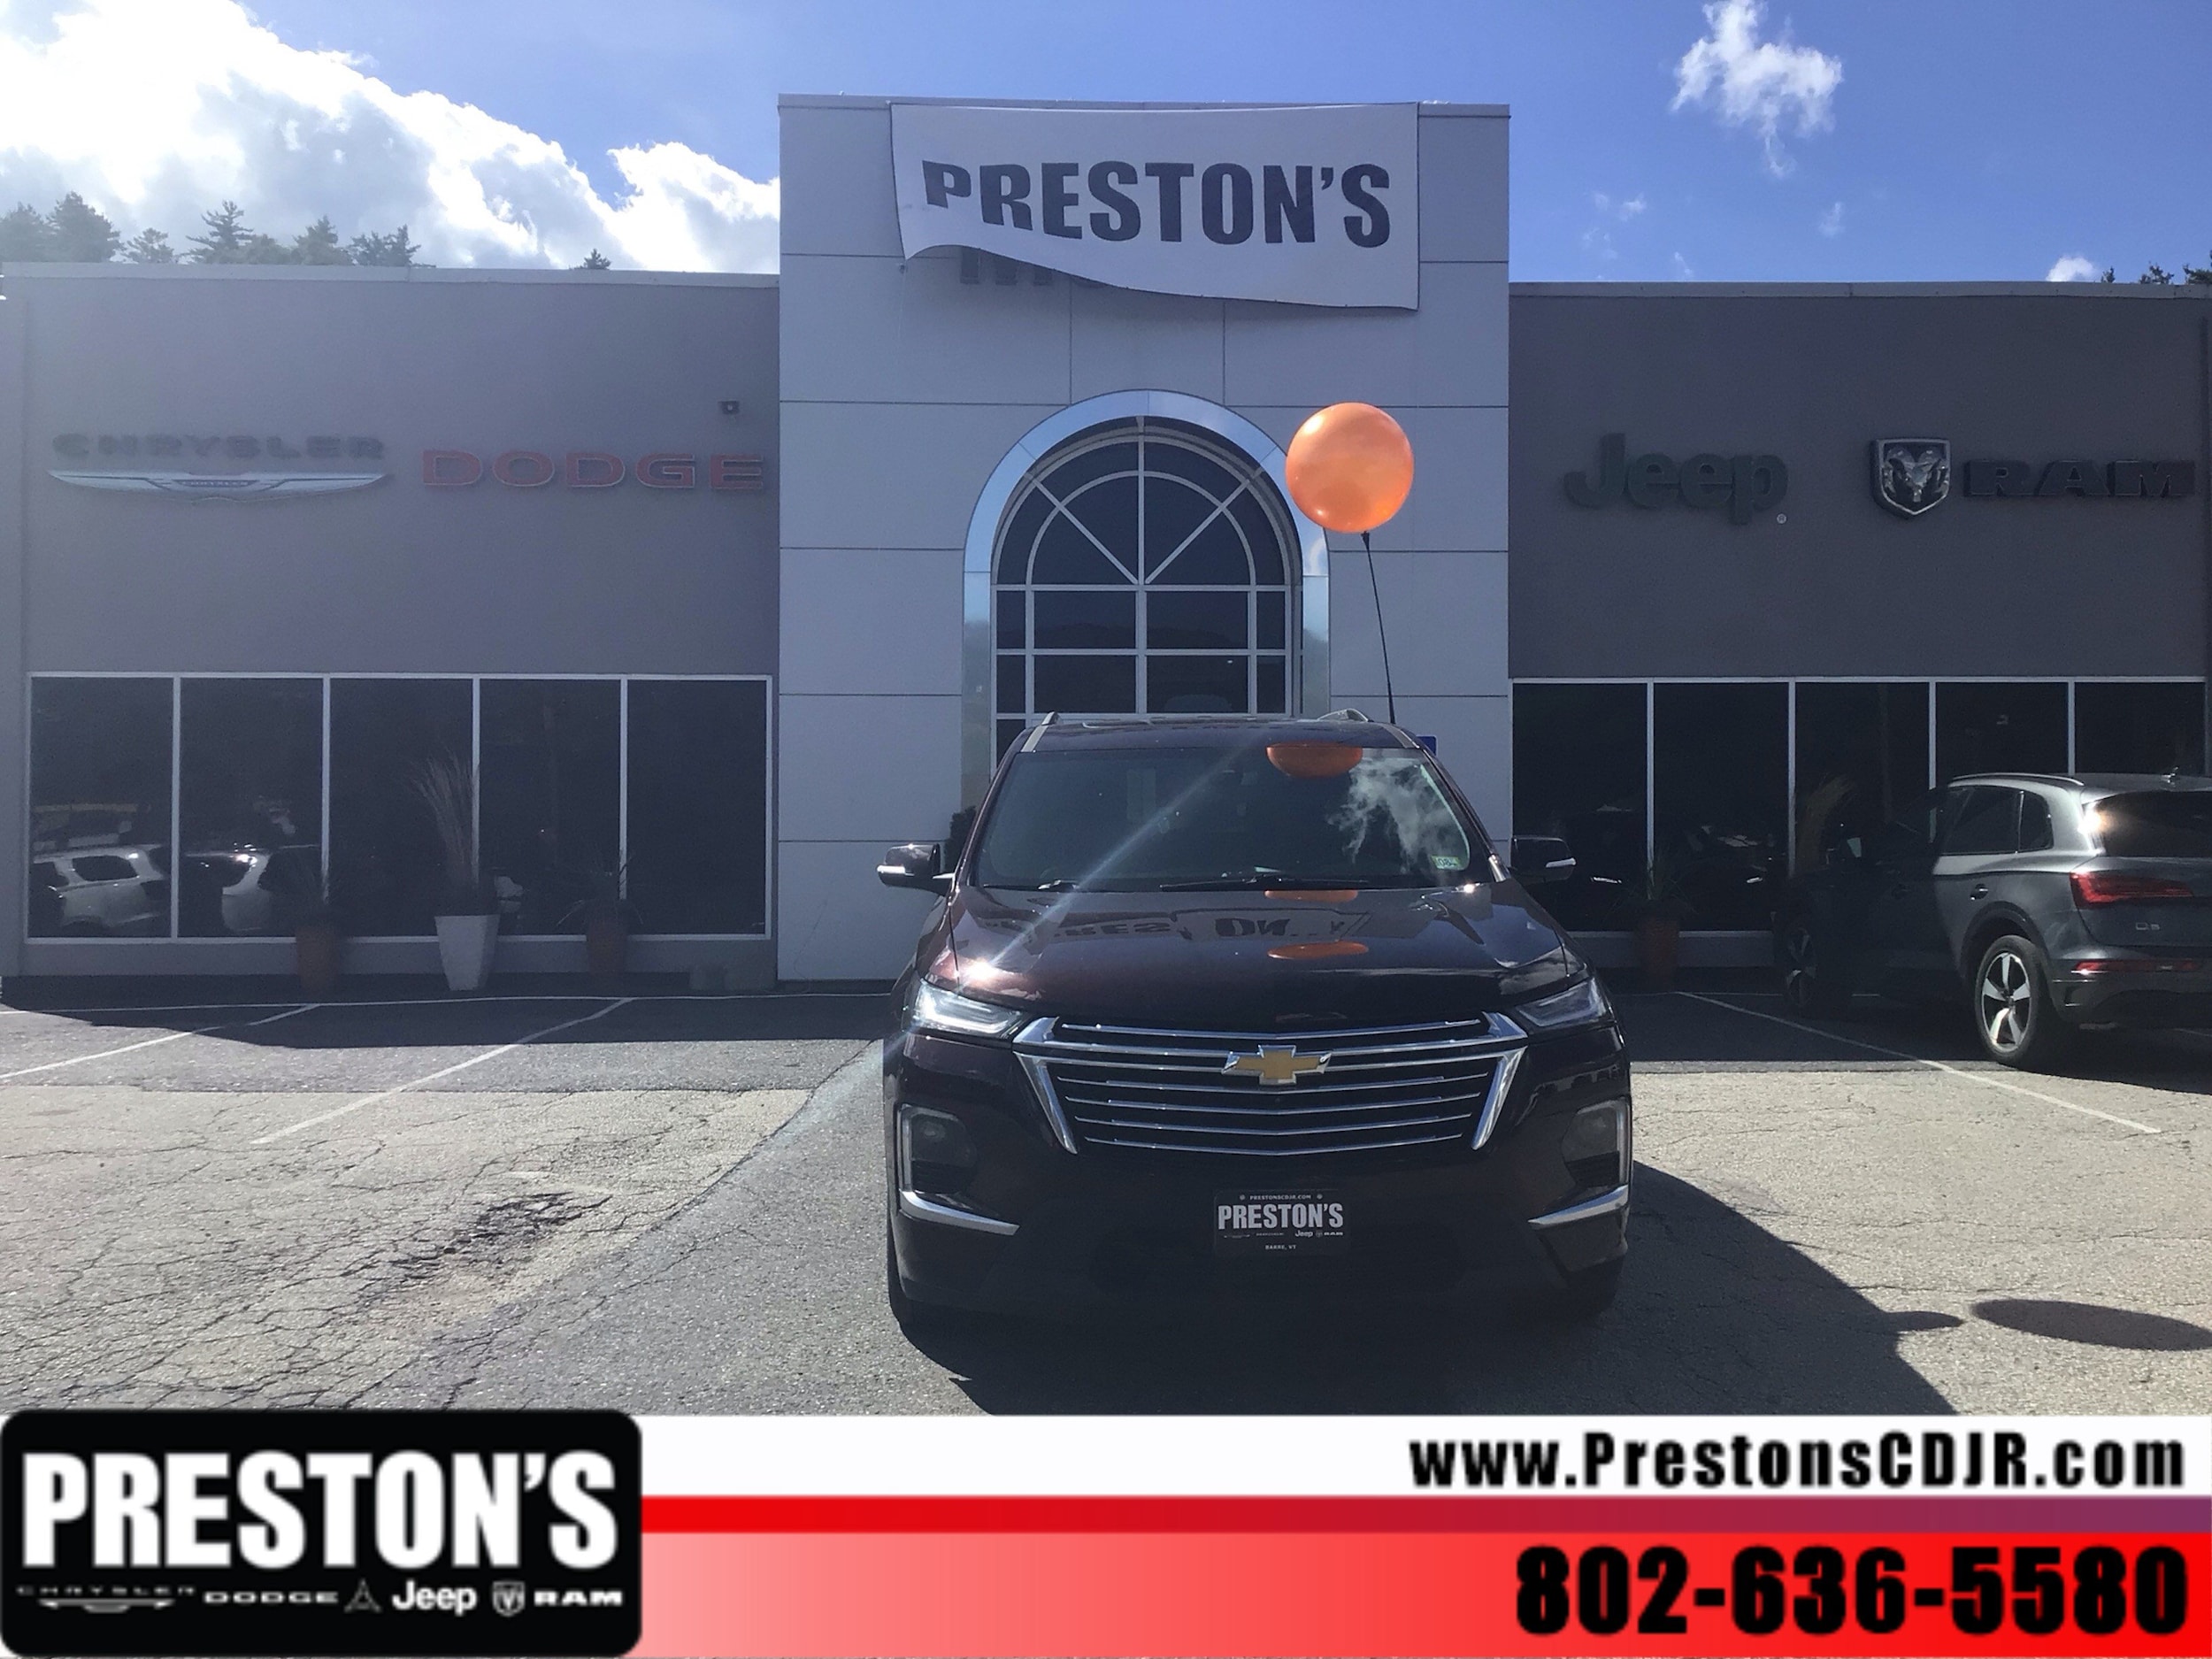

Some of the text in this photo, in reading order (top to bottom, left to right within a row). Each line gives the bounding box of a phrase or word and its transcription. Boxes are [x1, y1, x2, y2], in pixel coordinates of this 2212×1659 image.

[922, 160, 1390, 249] PRESTON'S
[51, 434, 386, 461] CHRYSLER
[421, 449, 764, 490] DODGE
[1563, 433, 1789, 526] Jeep
[1962, 457, 2196, 498] RAM
[1217, 1202, 1343, 1230] PRESTON'S
